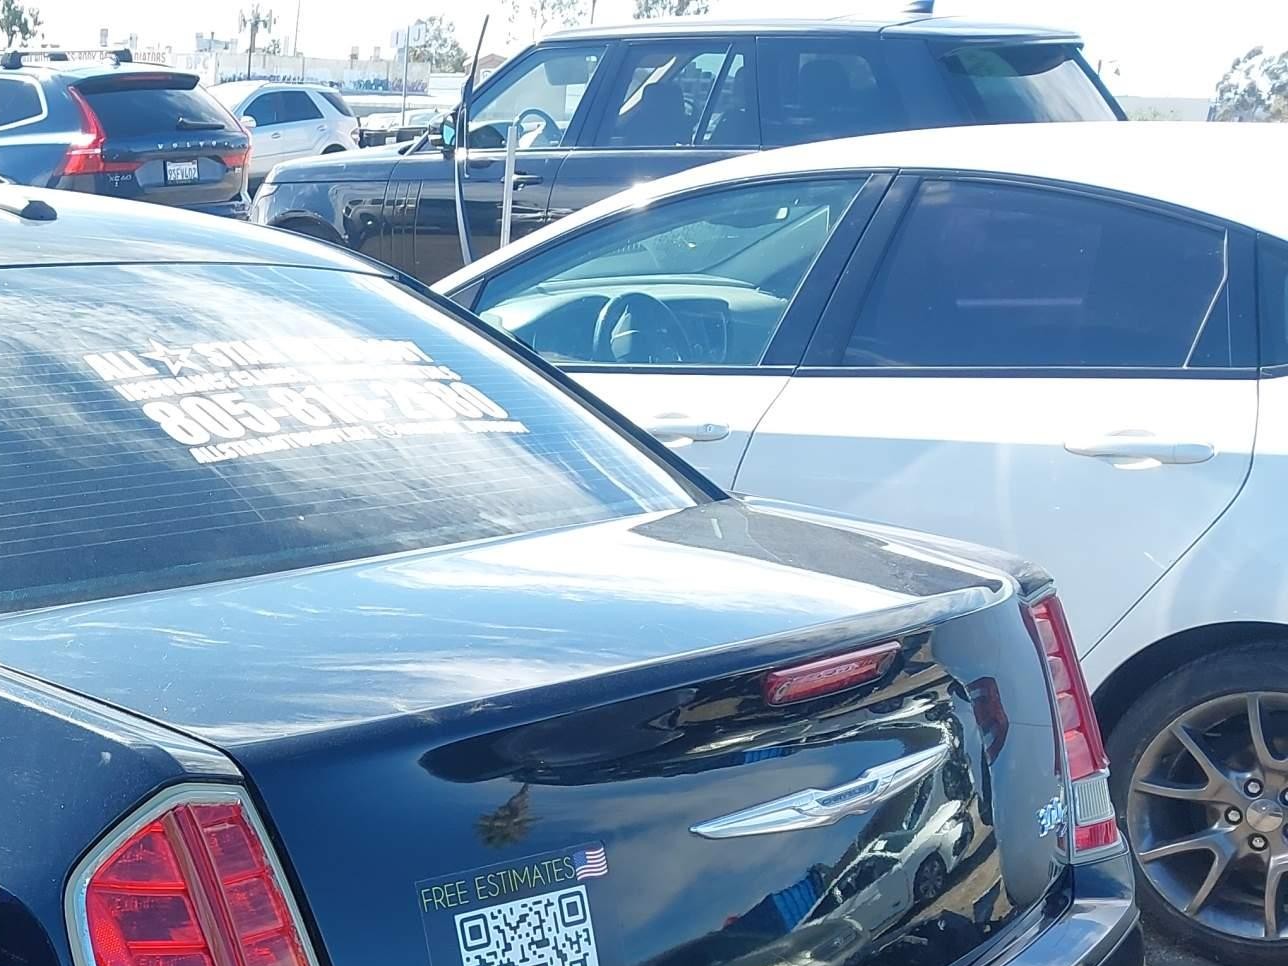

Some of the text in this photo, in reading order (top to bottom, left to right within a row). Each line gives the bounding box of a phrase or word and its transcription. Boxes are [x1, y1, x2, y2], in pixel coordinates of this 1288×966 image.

[157, 140, 218, 150] VOLVO
[83, 350, 158, 381] ALL
[421, 856, 575, 913] FREE ESTIMATES
